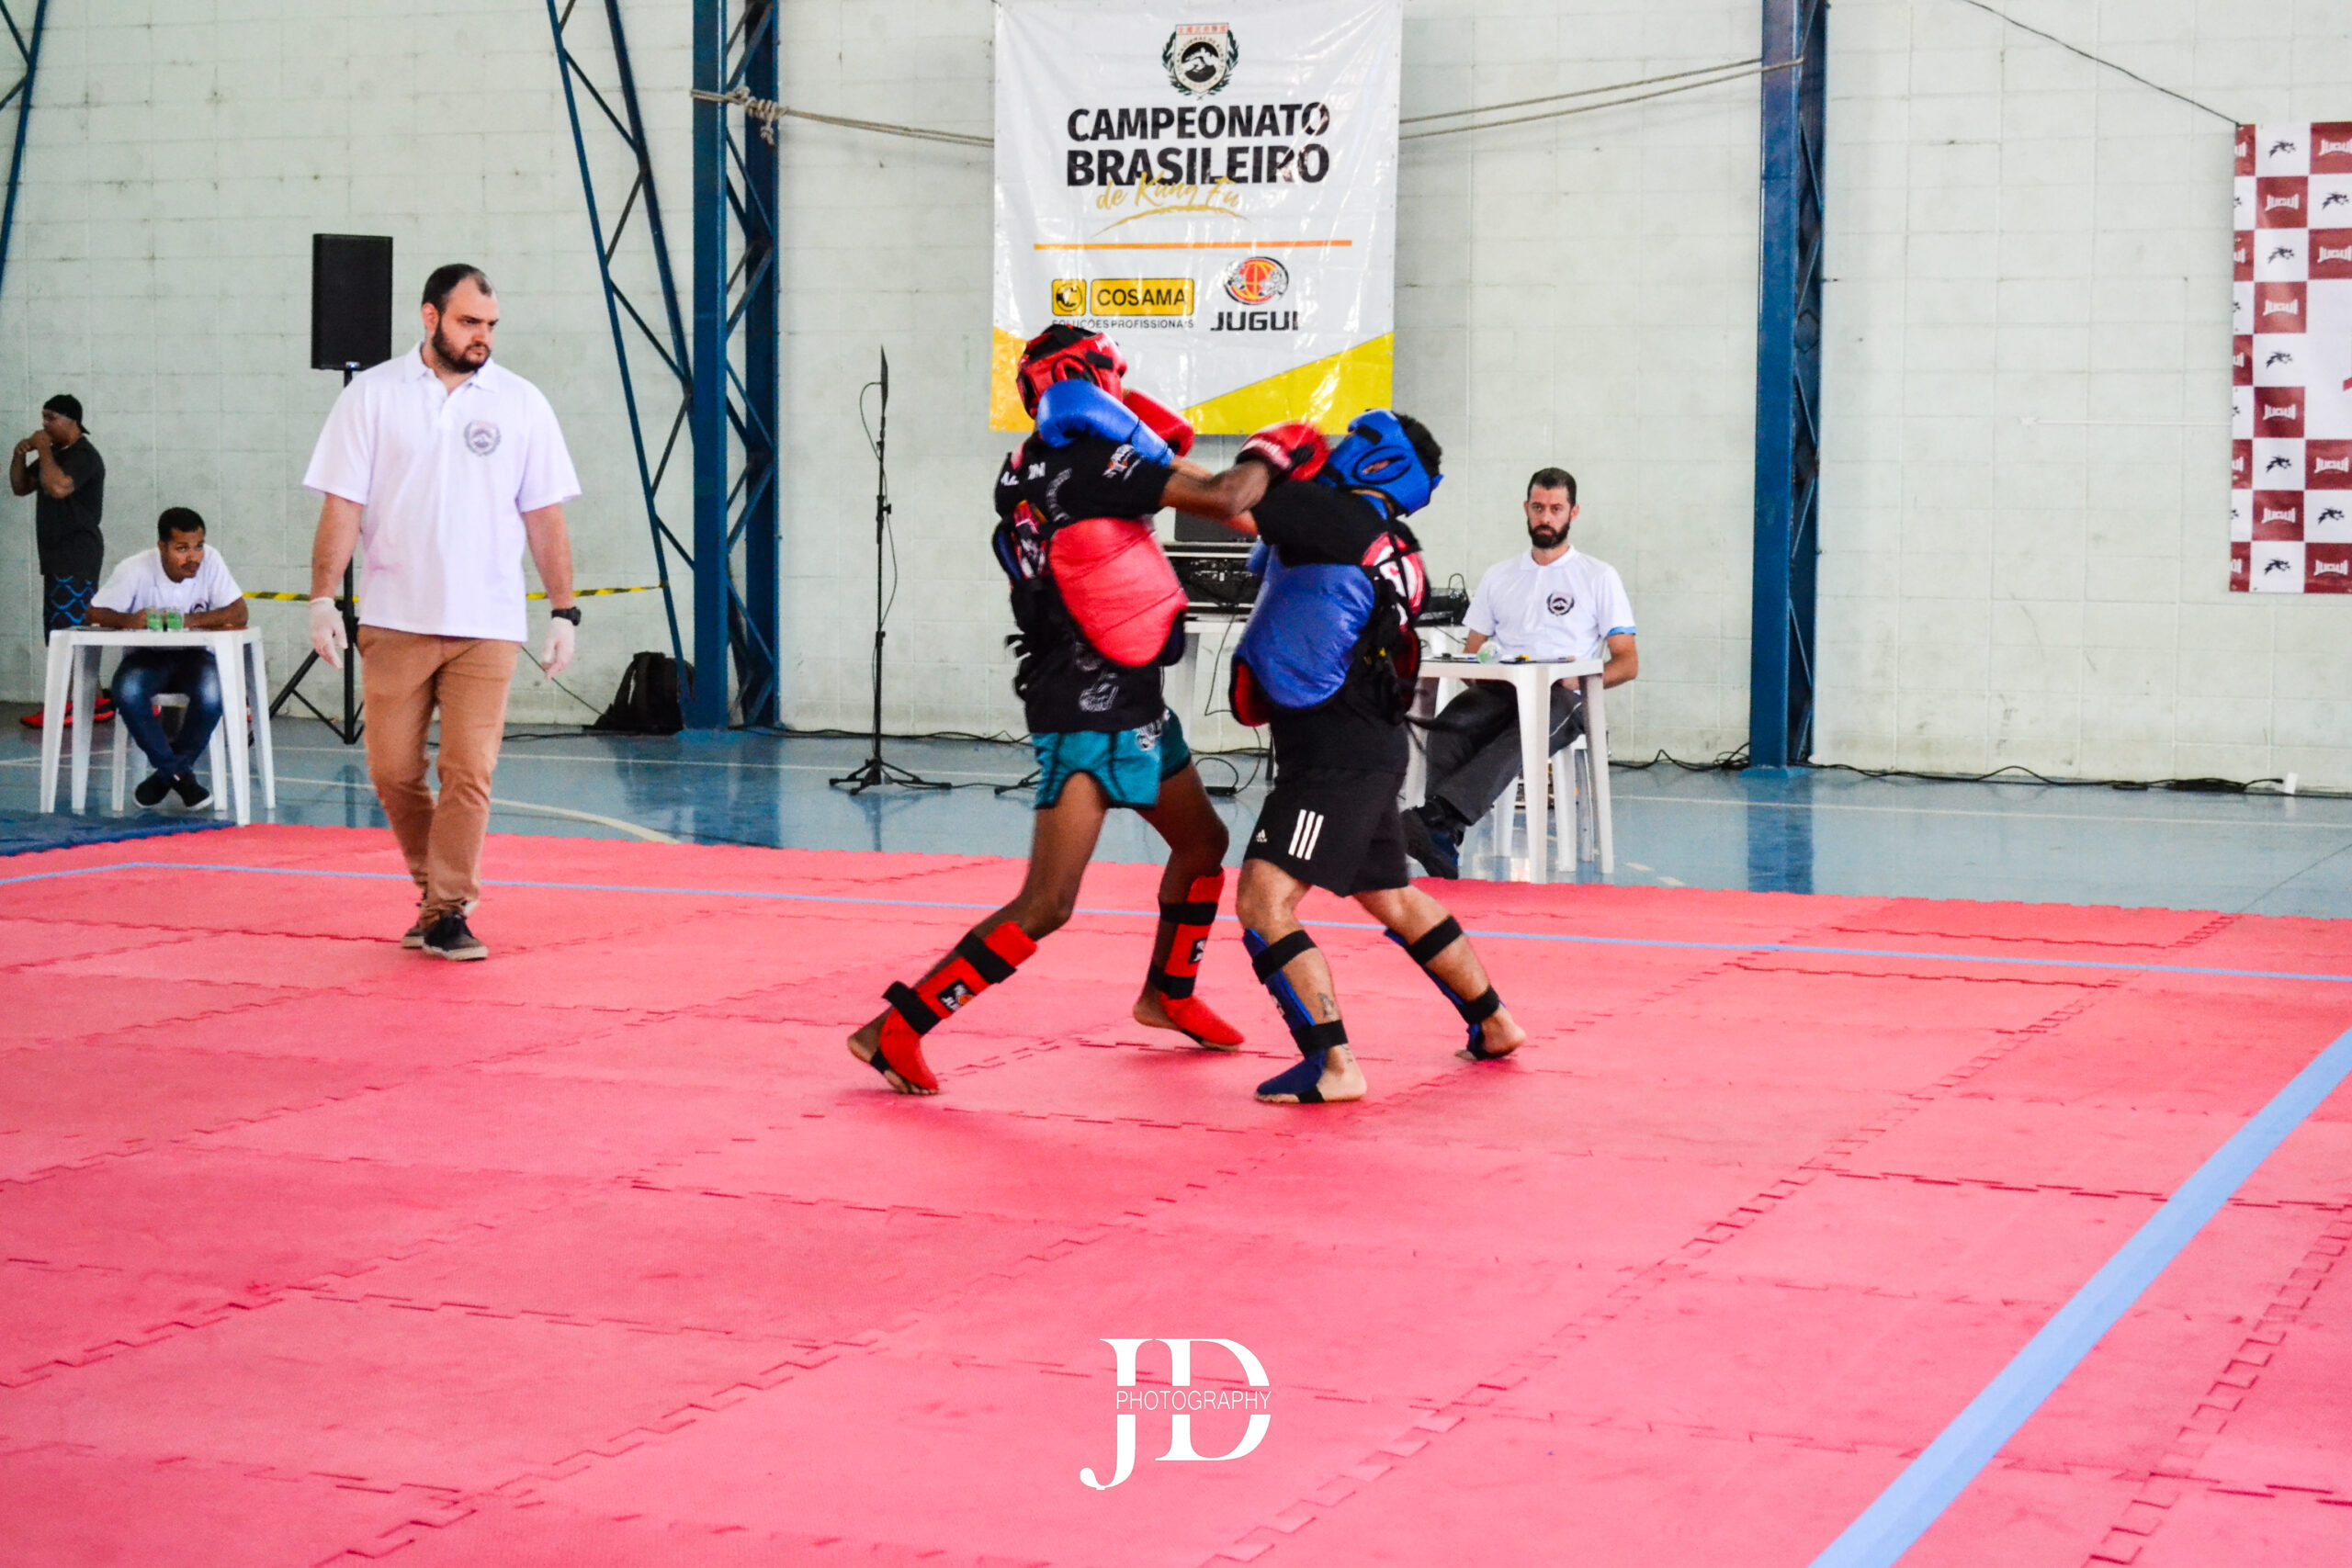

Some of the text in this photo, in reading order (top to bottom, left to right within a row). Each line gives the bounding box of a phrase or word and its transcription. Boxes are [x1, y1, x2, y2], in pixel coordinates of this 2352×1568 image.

[1068, 102, 1329, 142] CAMPEONATO
[1067, 143, 1329, 186] BRASILEIRO
[1096, 171, 1239, 209] de Kung Fu
[1097, 288, 1186, 307] COSAMA
[1210, 310, 1298, 332] JUGUI
